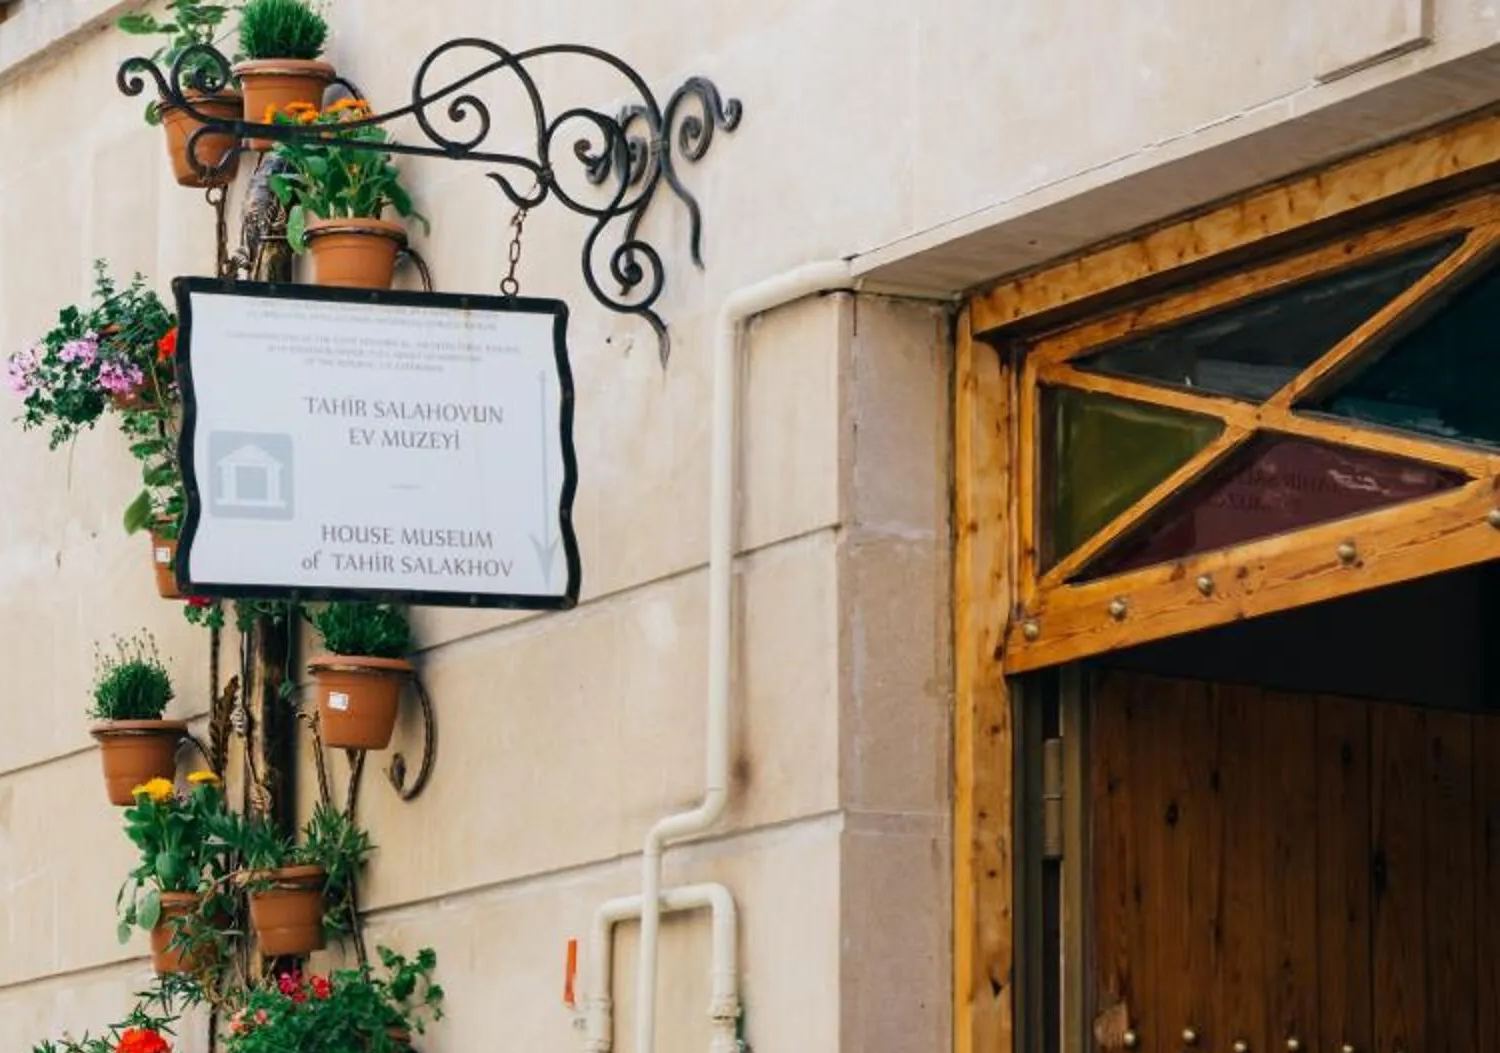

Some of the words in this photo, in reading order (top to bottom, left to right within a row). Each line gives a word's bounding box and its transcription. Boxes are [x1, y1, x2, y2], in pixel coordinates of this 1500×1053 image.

[373, 401, 504, 424] SALAHOVUN
[349, 427, 375, 446] EV
[382, 429, 460, 450] MUZEYİ
[321, 524, 395, 545] HOUSE
[401, 527, 494, 549] MUSEUM
[301, 550, 322, 570] of
[400, 556, 513, 577] SALAKHOV
